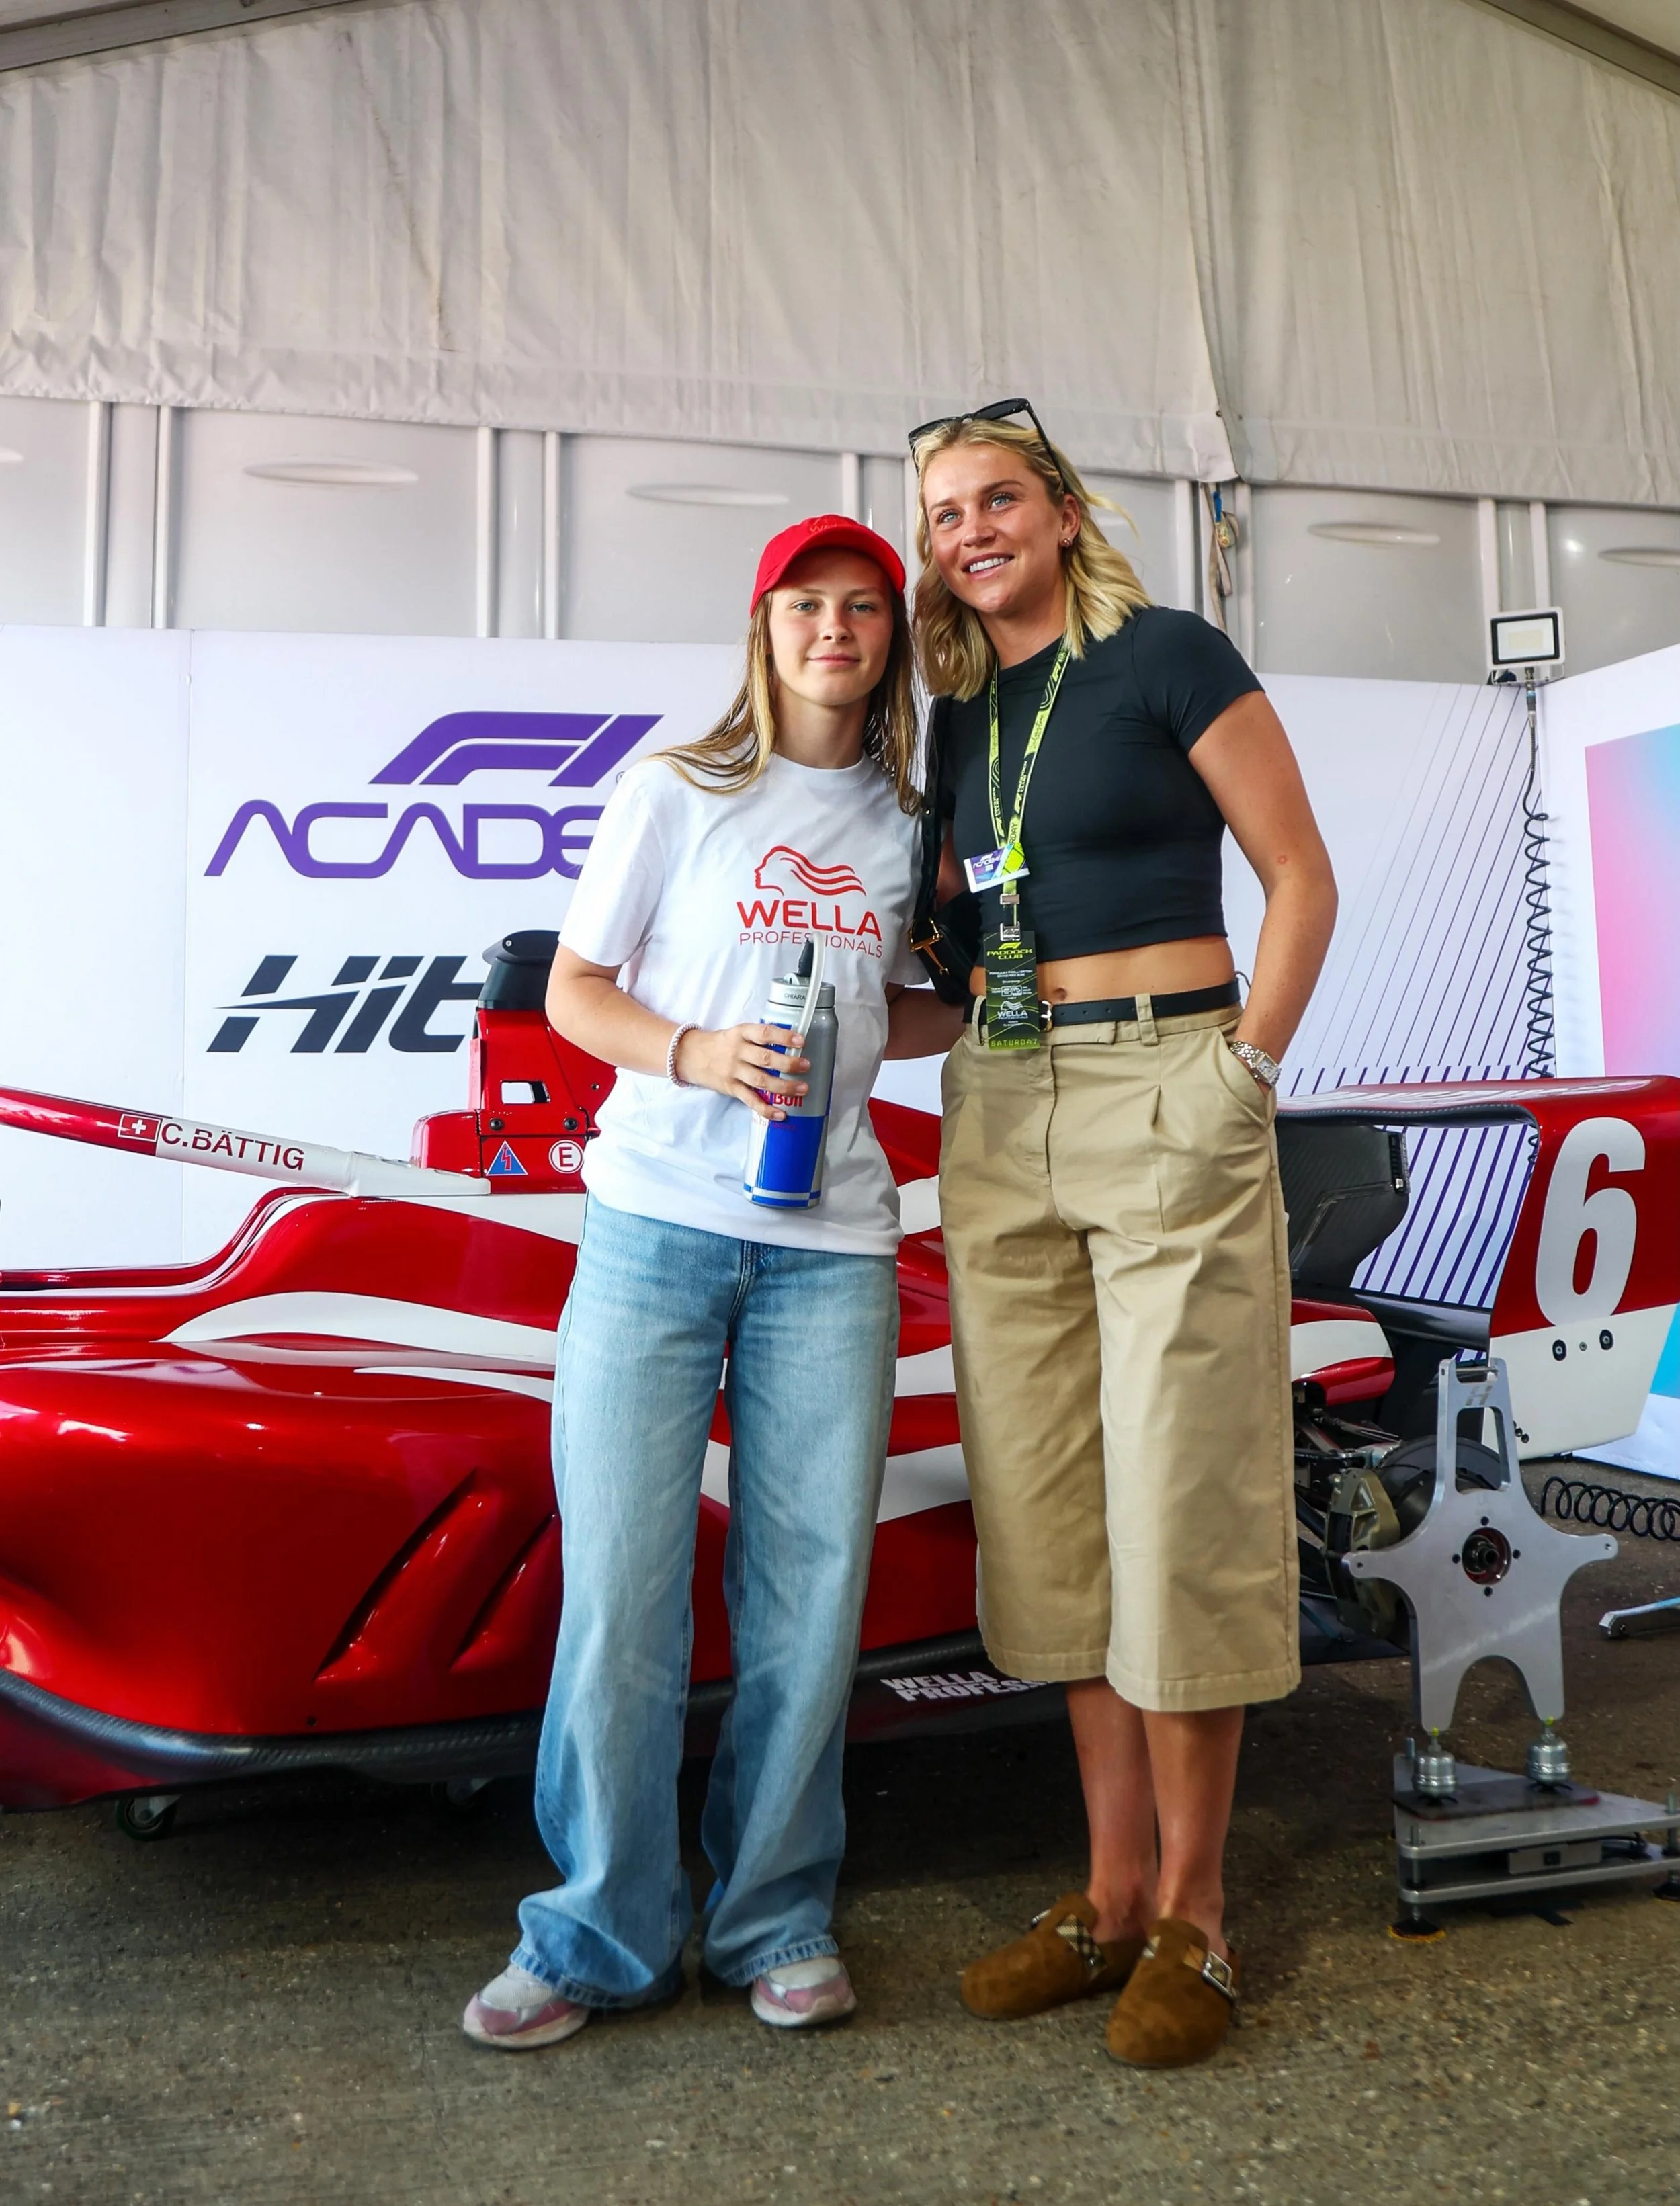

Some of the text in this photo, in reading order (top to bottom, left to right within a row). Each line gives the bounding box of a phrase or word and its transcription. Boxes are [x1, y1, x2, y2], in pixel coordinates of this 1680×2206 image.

[368, 711, 665, 787] F1
[203, 800, 606, 880] ACADE
[737, 900, 882, 941] WELLA
[740, 931, 883, 958] PROFESIONALS
[206, 955, 485, 1054] Hit
[991, 1038, 1038, 1047] SATURDAY
[773, 1093, 803, 1107] Bull
[161, 1123, 305, 1171] C.BÄTTIG
[559, 1146, 574, 1168] E
[1536, 1117, 1646, 1326] 6
[880, 1671, 999, 1690] WELLA
